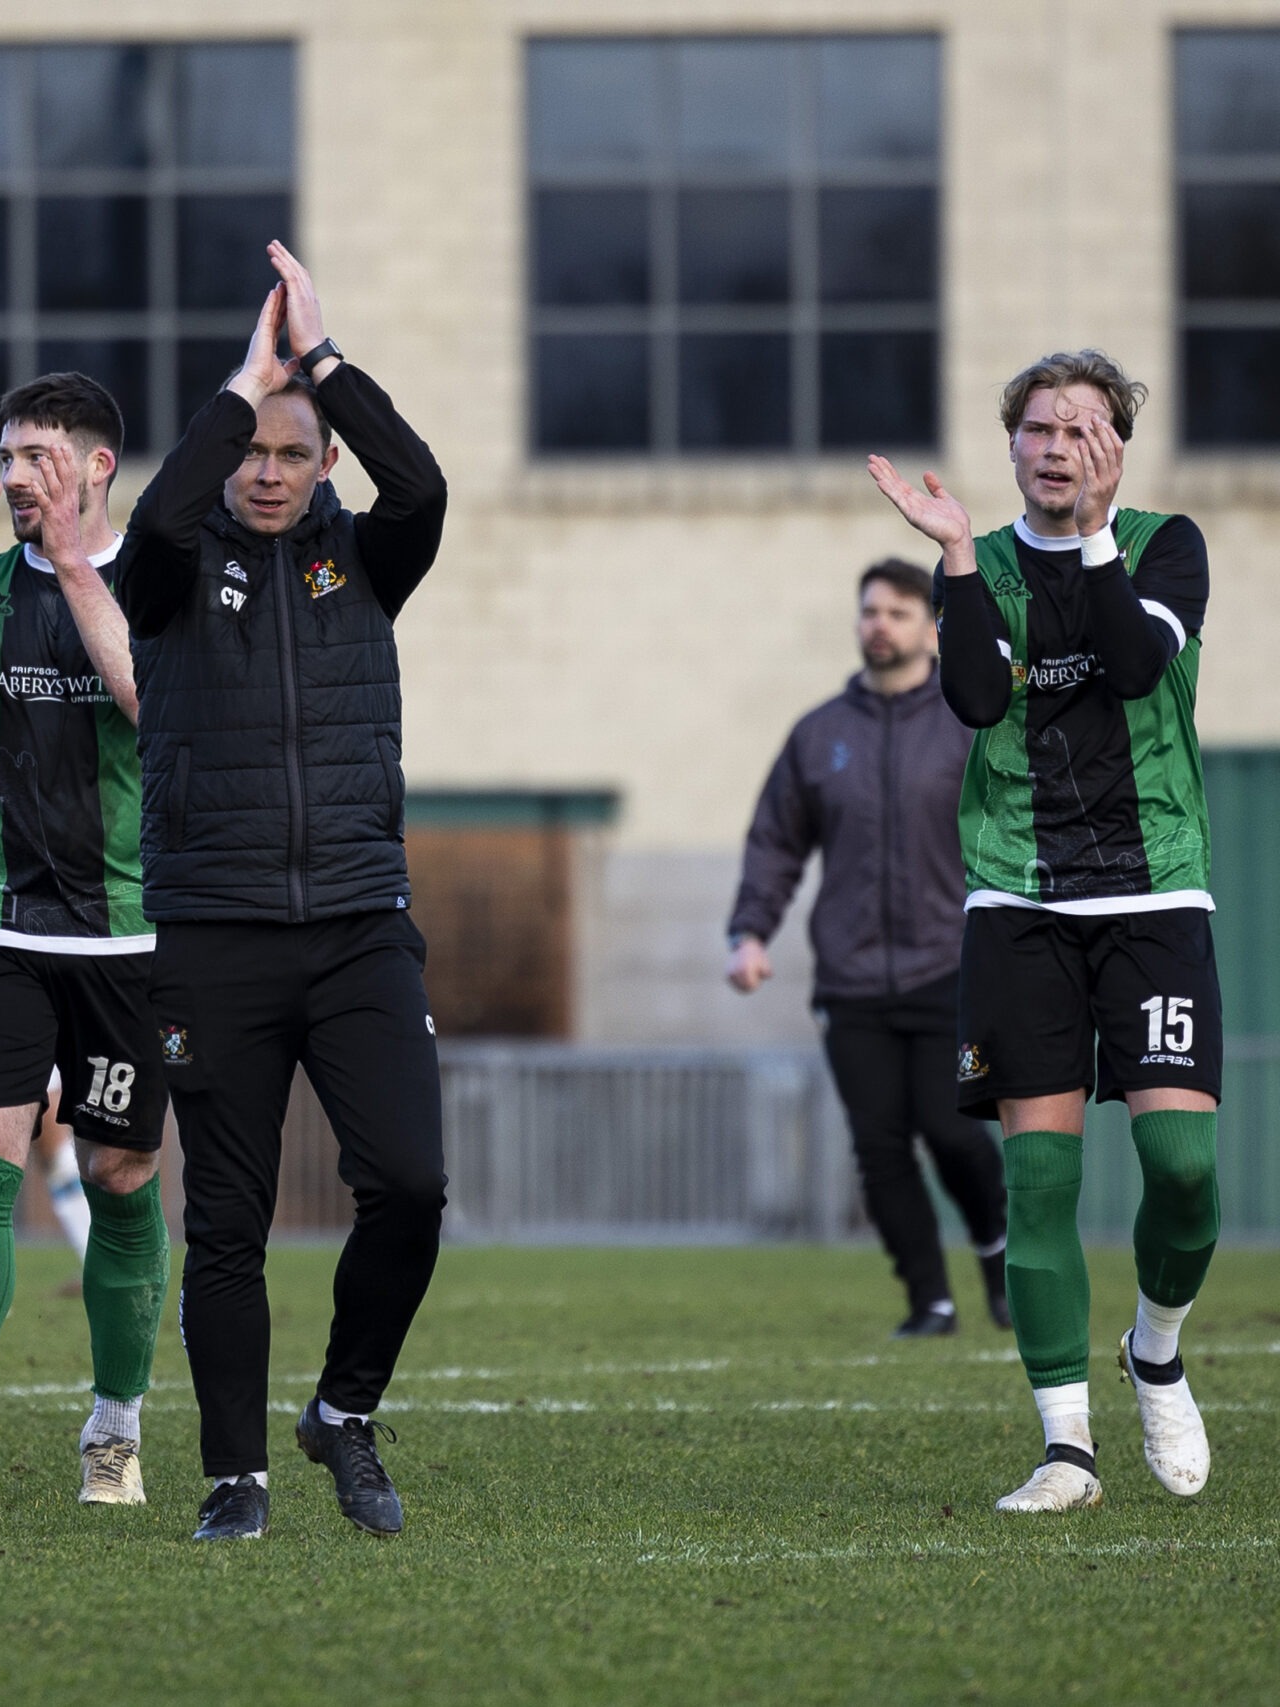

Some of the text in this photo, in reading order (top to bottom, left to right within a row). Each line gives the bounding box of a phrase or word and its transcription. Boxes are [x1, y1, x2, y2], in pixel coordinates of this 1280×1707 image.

[221, 587, 247, 611] CW
[11, 666, 59, 676] PRIFYSGO
[1140, 995, 1194, 1053] 15
[86, 1056, 136, 1112] 18
